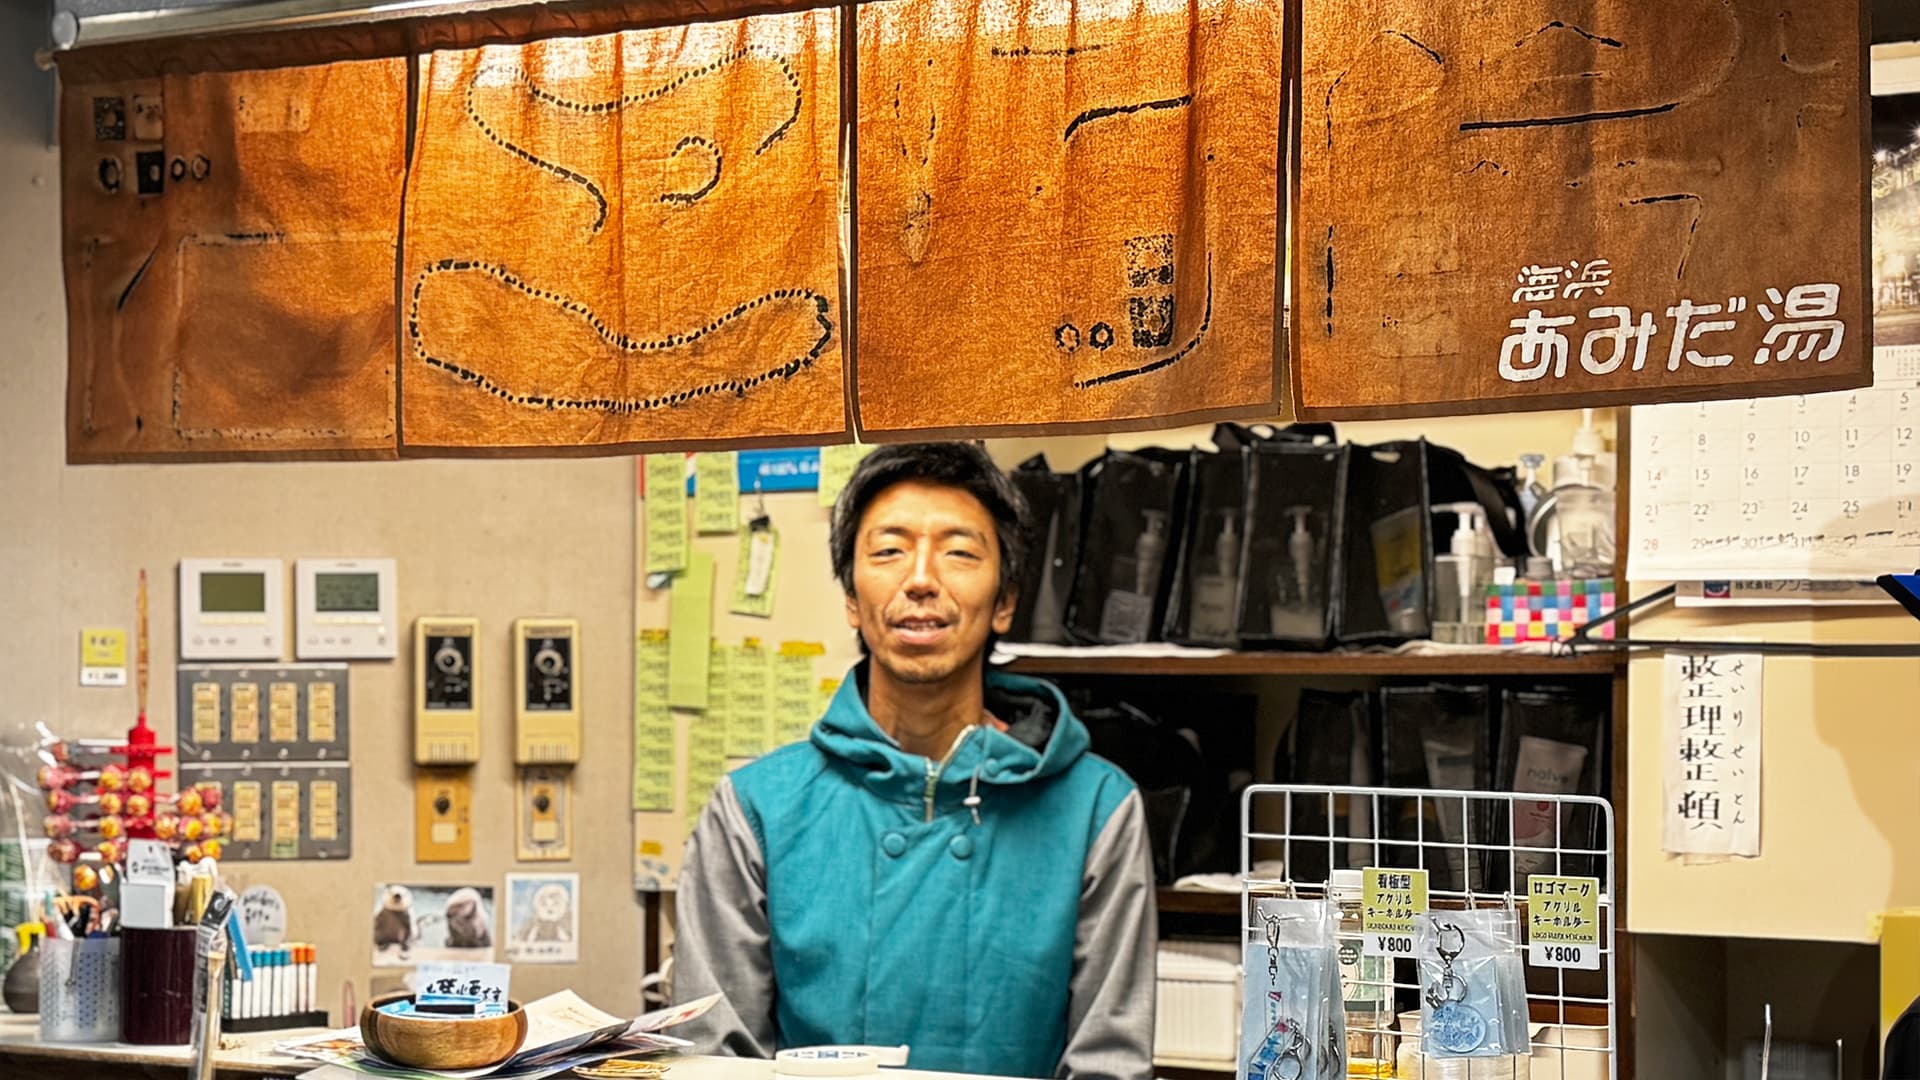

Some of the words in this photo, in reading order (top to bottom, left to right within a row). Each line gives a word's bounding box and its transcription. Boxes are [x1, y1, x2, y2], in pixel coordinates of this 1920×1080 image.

[1513, 259, 1612, 302] 海浜
[1499, 283, 1845, 381] あみだ湯
[1900, 392, 1909, 404] 5
[1651, 435, 1658, 447] 7
[1698, 433, 1706, 446] 8
[1747, 432, 1756, 444] 9
[1795, 431, 1810, 443] 10
[1845, 429, 1858, 441] 11
[1896, 427, 1912, 440] 12
[1648, 470, 1661, 481] 14
[1695, 468, 1710, 480] 15
[1744, 467, 1759, 479] 16
[1794, 466, 1809, 478] 17
[1845, 465, 1859, 477] 18
[1896, 463, 1912, 475] 19
[1645, 504, 1658, 516] 21
[1693, 503, 1709, 515] 22
[1742, 502, 1758, 514] 23
[1792, 502, 1808, 513] 24
[1843, 500, 1859, 513] 25
[1643, 538, 1658, 550] 28
[1678, 655, 1725, 829] 整理整頓
[1378, 873, 1411, 889] 看板型
[1534, 881, 1590, 897] ロゴマーク
[1377, 893, 1412, 905] アクリル
[1544, 901, 1581, 913] アクリル
[1378, 936, 1412, 952] ¥800
[1544, 946, 1581, 963] ¥800
